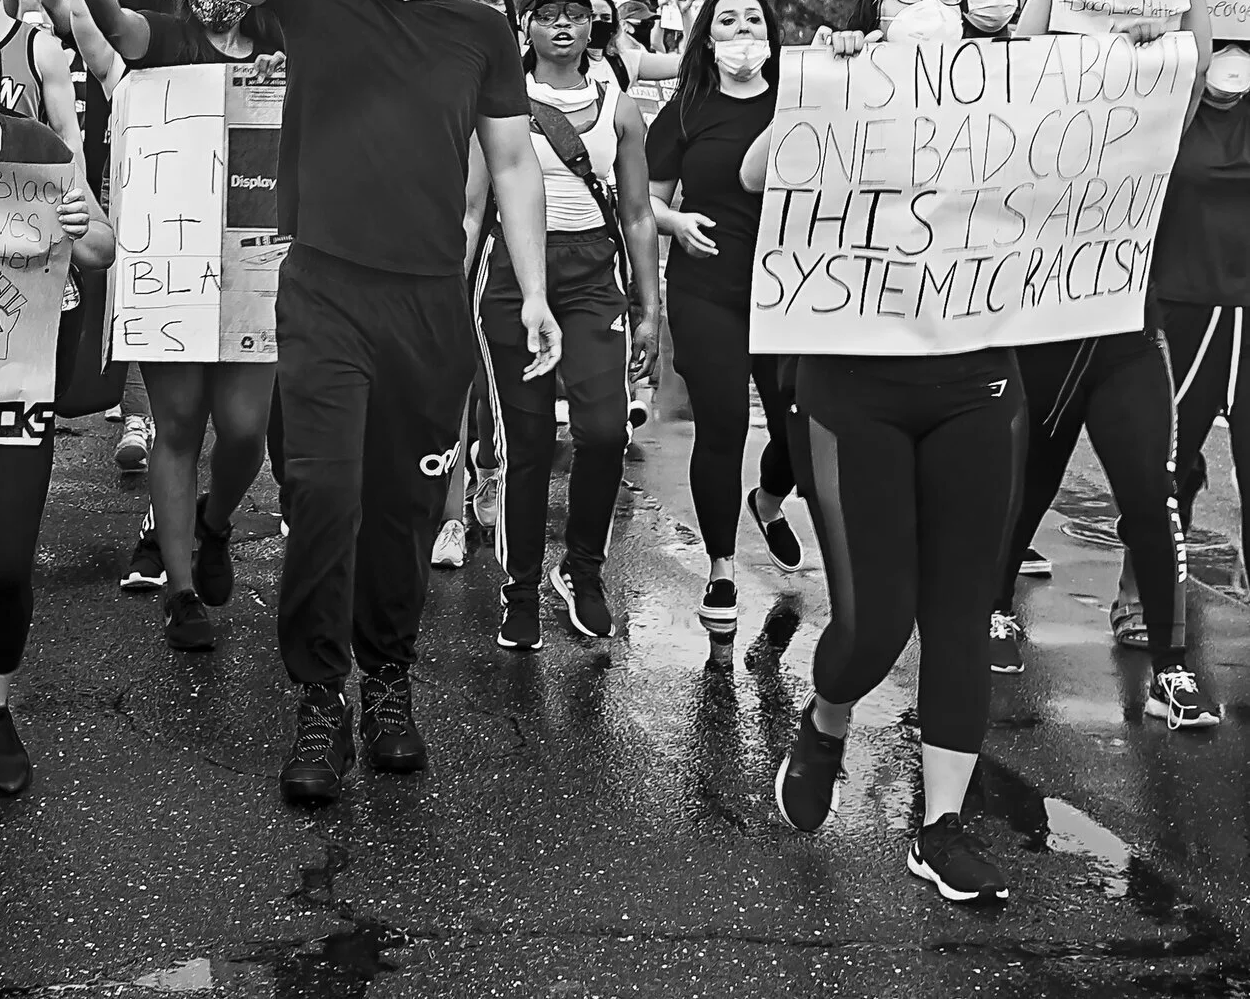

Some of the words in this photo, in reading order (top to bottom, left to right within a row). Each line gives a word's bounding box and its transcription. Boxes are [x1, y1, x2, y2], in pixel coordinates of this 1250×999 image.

[915, 36, 1031, 109] NOT
[1031, 34, 1180, 105] ABOUT
[230, 174, 277, 192] Display
[773, 117, 896, 187] ONE
[911, 114, 1017, 188] BAD
[1028, 106, 1140, 180] COP
[768, 186, 938, 256] THIS
[943, 183, 1035, 253] IS
[1036, 172, 1169, 241] ABOUT
[756, 249, 1021, 319] SYSTEMIC
[1021, 238, 1152, 310] RACISM
